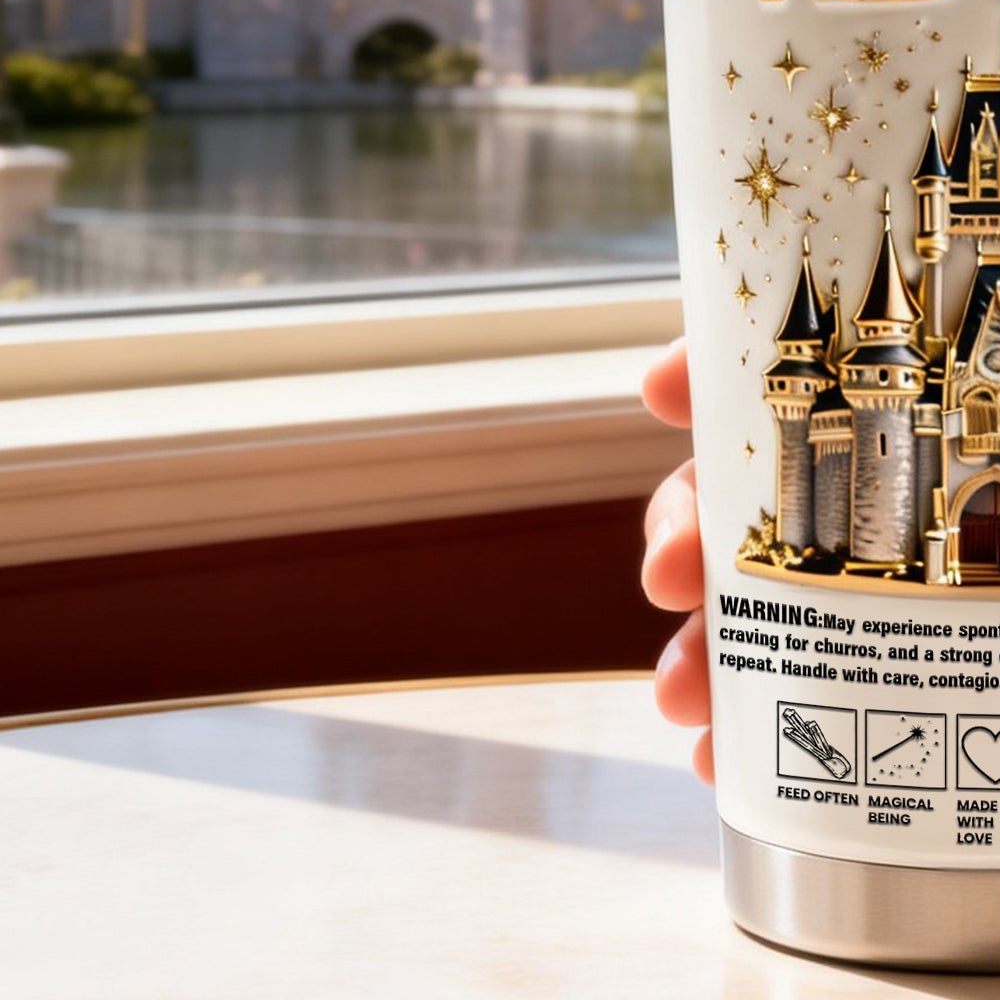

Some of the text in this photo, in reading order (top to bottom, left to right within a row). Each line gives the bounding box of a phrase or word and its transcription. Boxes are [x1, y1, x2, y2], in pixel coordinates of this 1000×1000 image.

[862, 619, 952, 638] experience
[720, 627, 779, 650] craving
[785, 634, 809, 650] for
[815, 638, 882, 660] churros,
[888, 645, 918, 660] and
[924, 649, 934, 661] a
[940, 647, 992, 666] strong
[720, 652, 777, 673] repeat.
[782, 659, 837, 679] Handle
[842, 667, 878, 684] with
[883, 672, 924, 688] care,
[777, 786, 859, 806] FEED OFTEN
[868, 796, 934, 811] MAGICAL
[957, 800, 998, 811] MADE
[868, 812, 911, 825] BEING
[957, 816, 994, 828] WITH
[957, 833, 993, 844] LOVE
